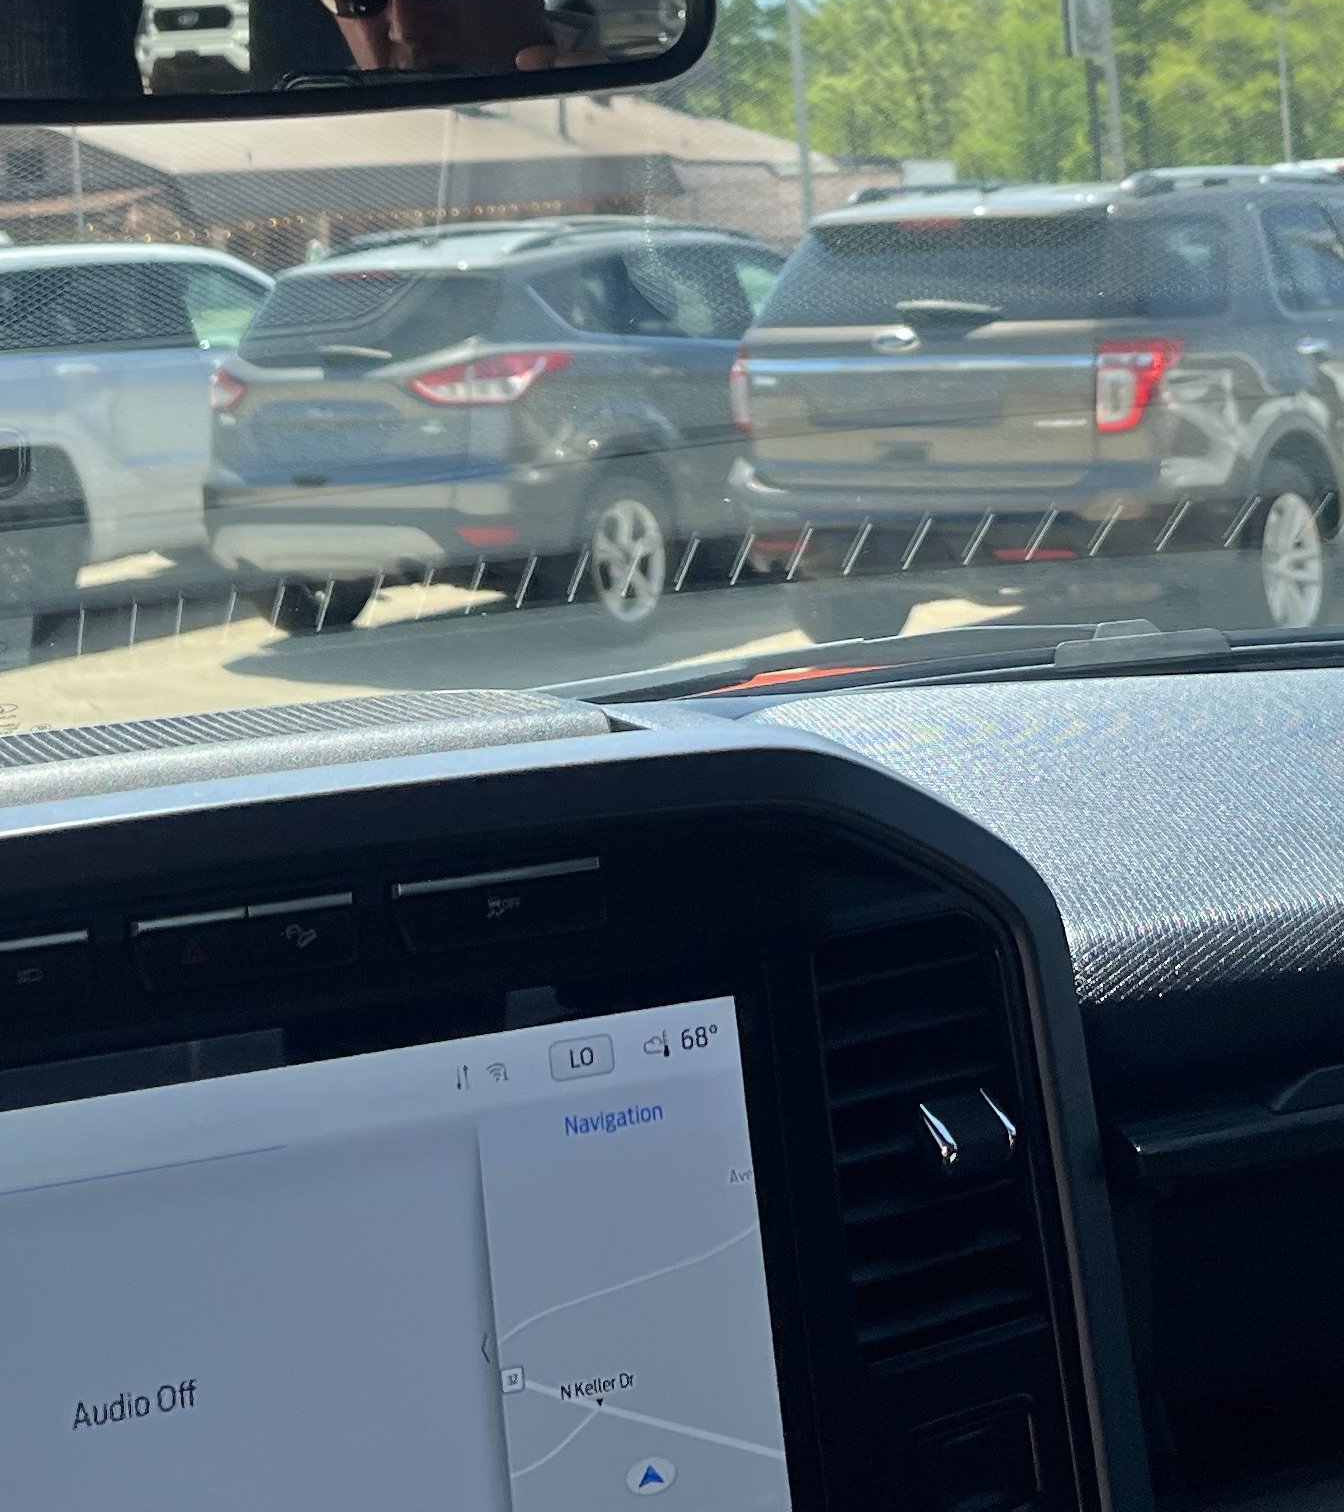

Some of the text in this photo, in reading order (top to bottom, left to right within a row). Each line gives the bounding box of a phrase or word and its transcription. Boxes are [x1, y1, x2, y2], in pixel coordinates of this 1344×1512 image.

[569, 1046, 594, 1070] LO
[563, 1103, 664, 1137] Navigation
[560, 1373, 635, 1401] N Keller Dr
[71, 1379, 198, 1431] Audio Off
